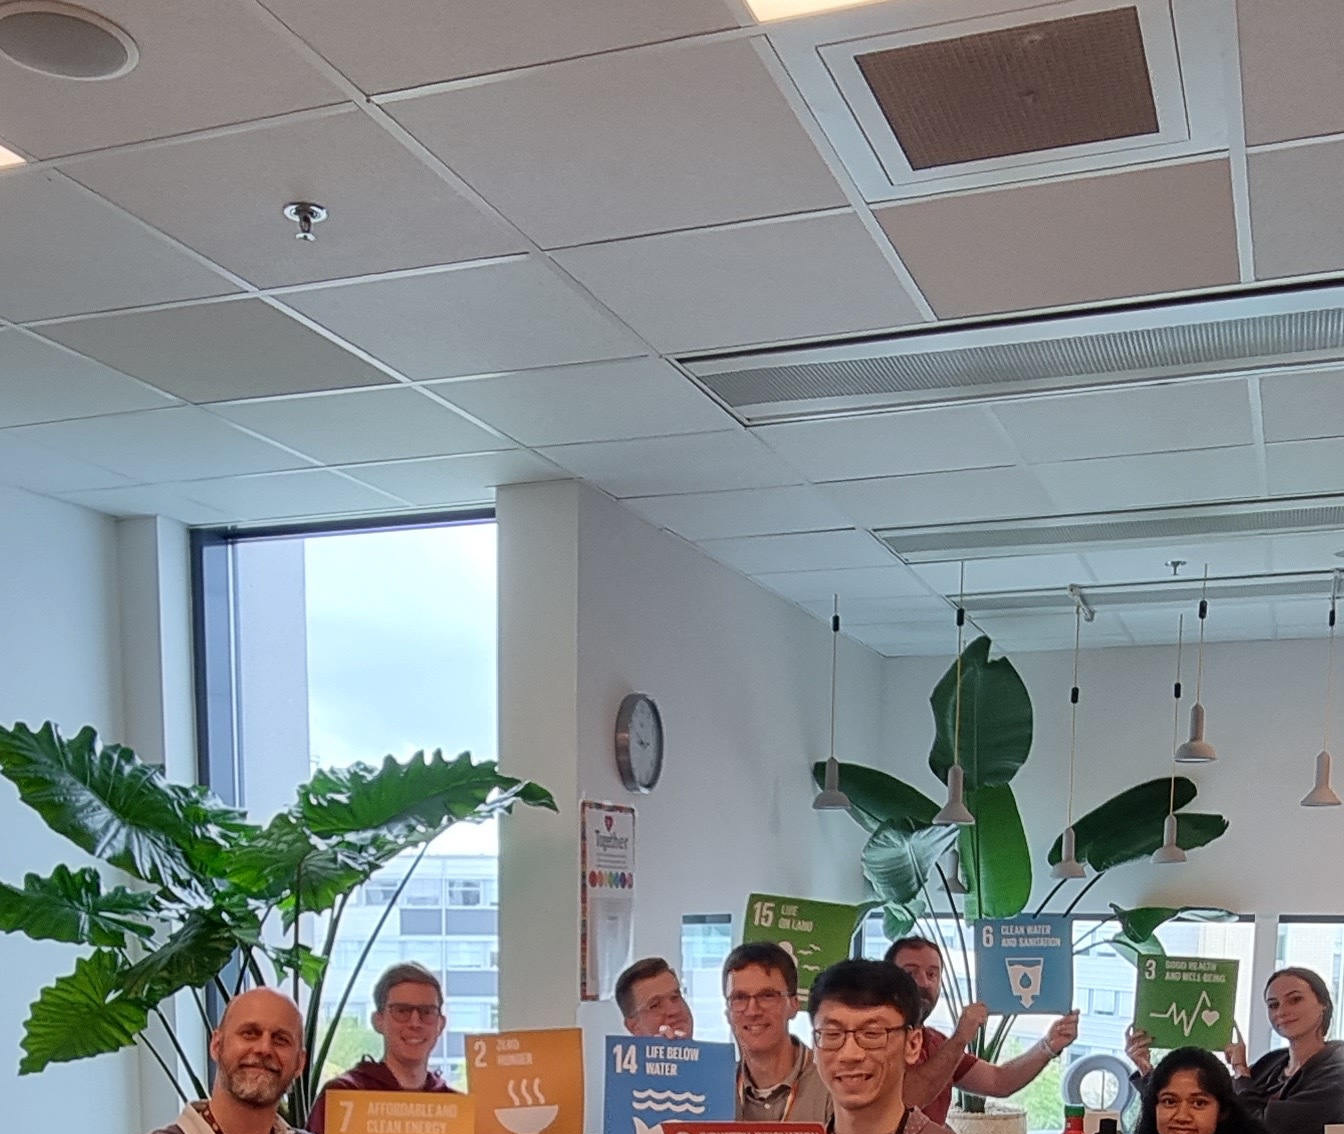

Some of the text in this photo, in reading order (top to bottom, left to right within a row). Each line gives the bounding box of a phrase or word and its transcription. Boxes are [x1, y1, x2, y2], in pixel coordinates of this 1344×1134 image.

[753, 901, 776, 928] 15
[982, 924, 994, 948] 6
[1001, 925, 1052, 935] CLEAN WATER
[1001, 937, 1017, 948] AND
[1145, 959, 1156, 981] 3
[474, 1039, 488, 1068] 2
[613, 1044, 638, 1074] 14
[645, 1045, 700, 1061] LIFE BELOW
[645, 1061, 678, 1076] WATER
[339, 1100, 354, 1134] 7
[367, 1102, 457, 1119] AFFORDABLE AND
[367, 1119, 403, 1134] CLEAN
